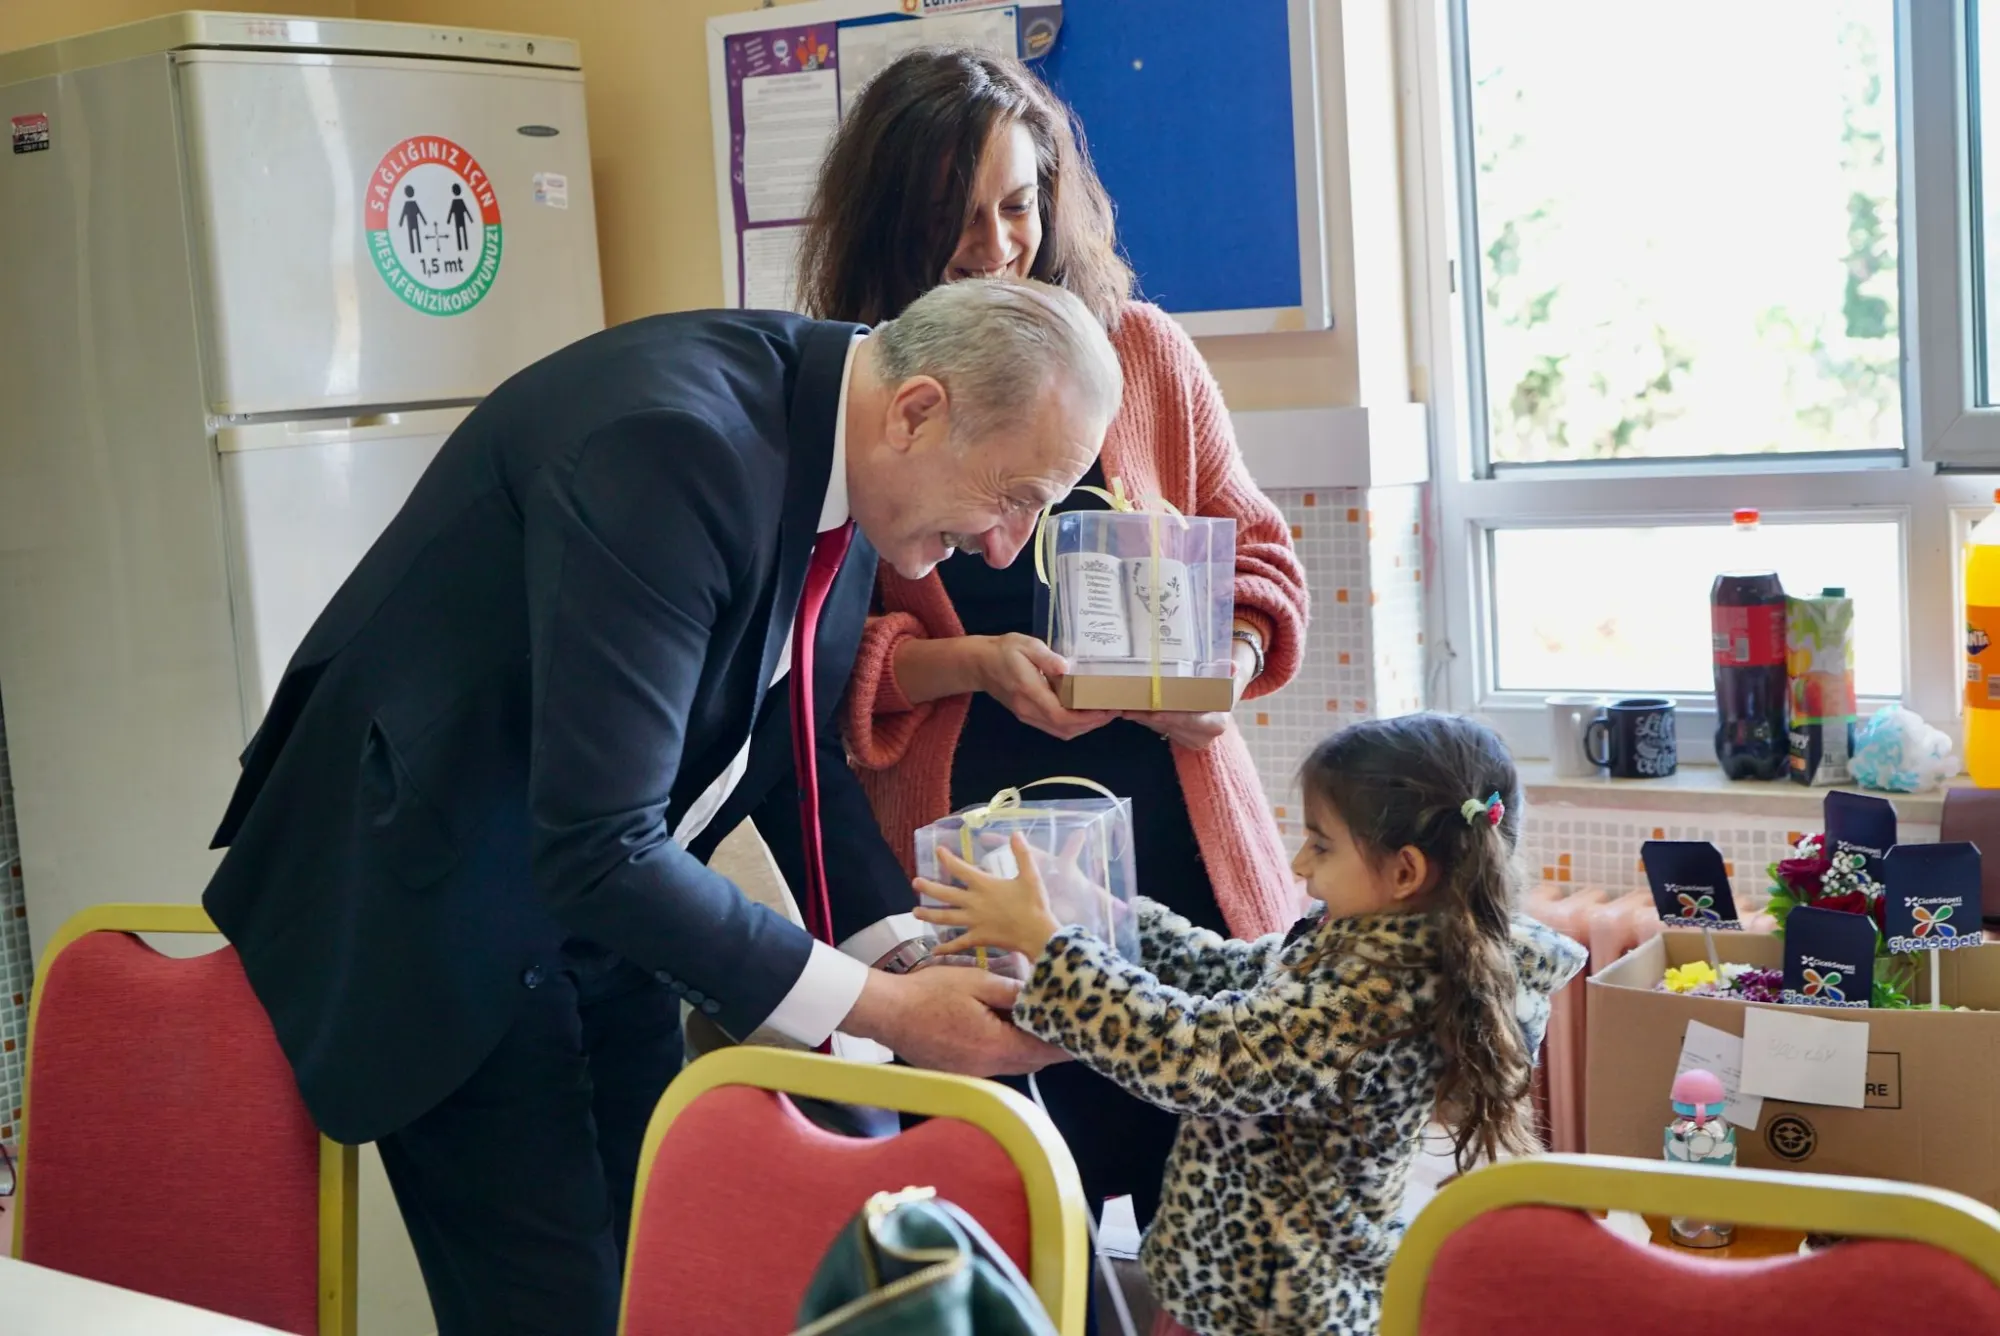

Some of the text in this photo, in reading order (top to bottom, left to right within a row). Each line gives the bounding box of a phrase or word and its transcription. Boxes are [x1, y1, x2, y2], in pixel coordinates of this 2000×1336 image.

[371, 141, 460, 213] SAĞLIĞINIZ
[463, 158, 494, 208] İÇİN
[420, 257, 464, 278] 1,5 mt
[1865, 1083, 1889, 1096] RE
